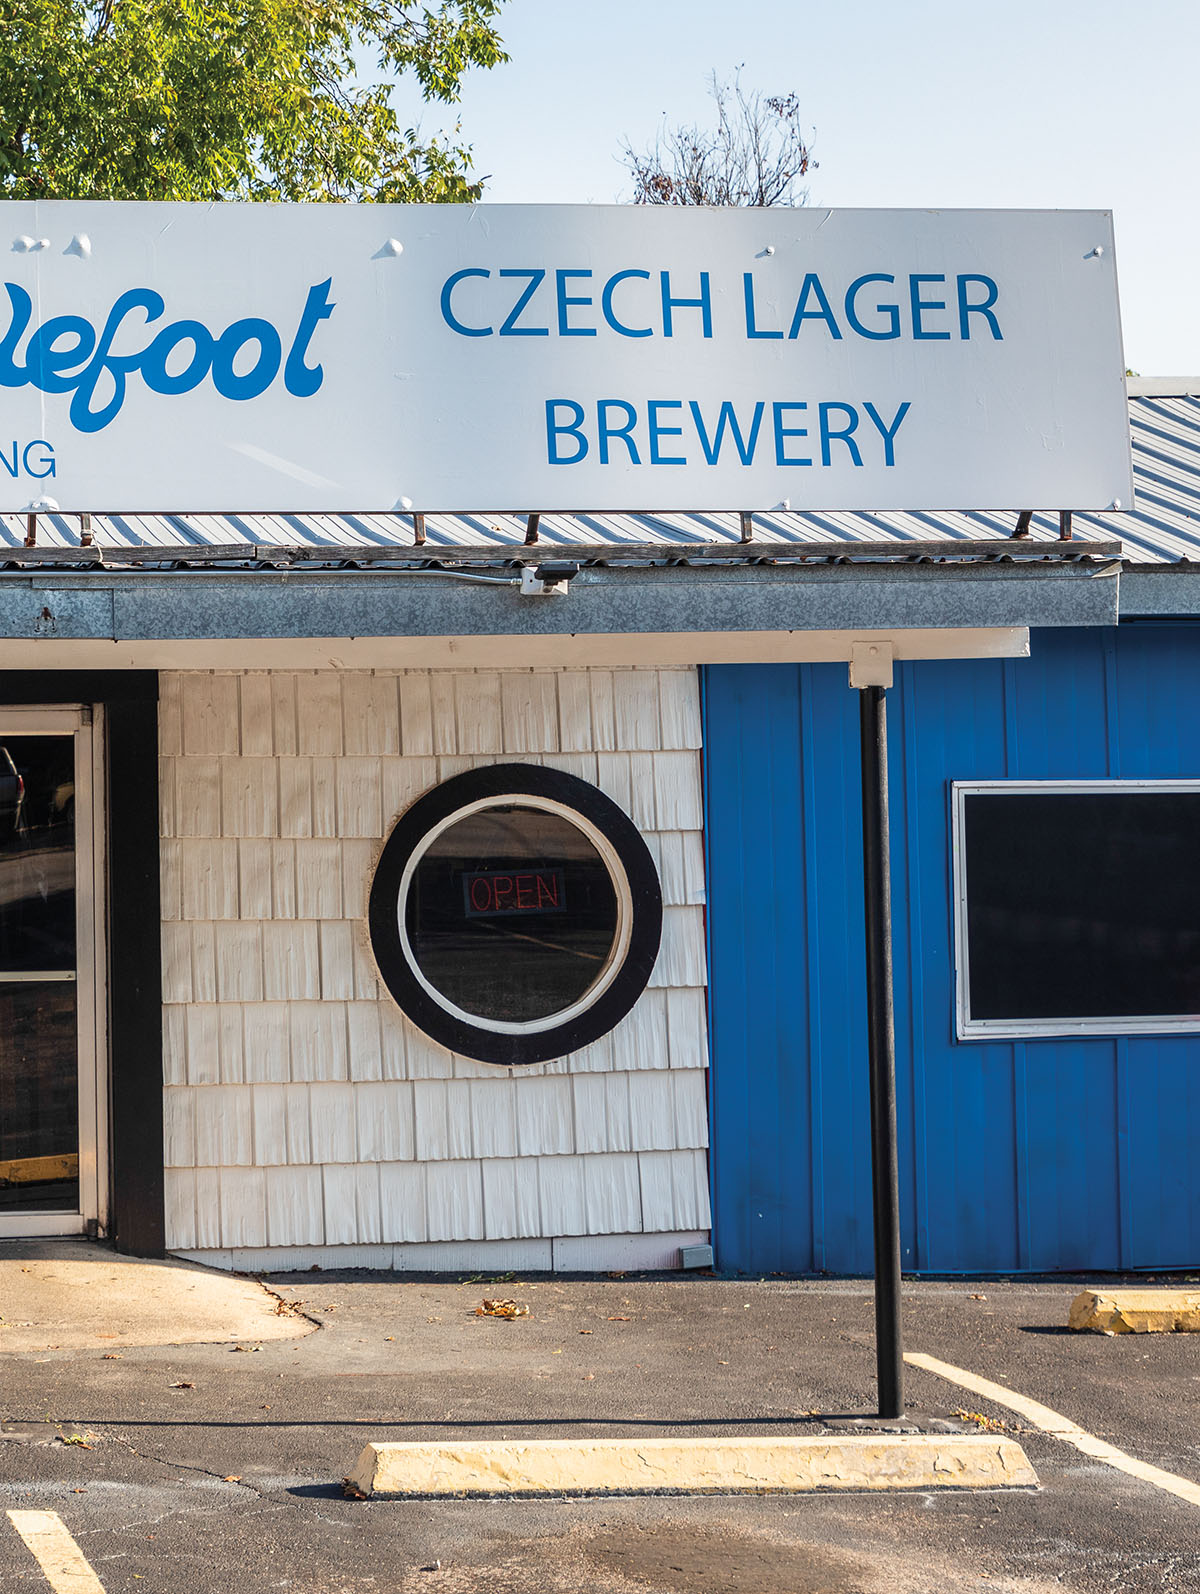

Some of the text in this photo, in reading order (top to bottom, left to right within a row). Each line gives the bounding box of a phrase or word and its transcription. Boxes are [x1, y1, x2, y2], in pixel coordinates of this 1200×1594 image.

[440, 267, 1004, 342] CZECH LAGER
[545, 398, 912, 468] BREWERY
[471, 872, 559, 911] OPEN
